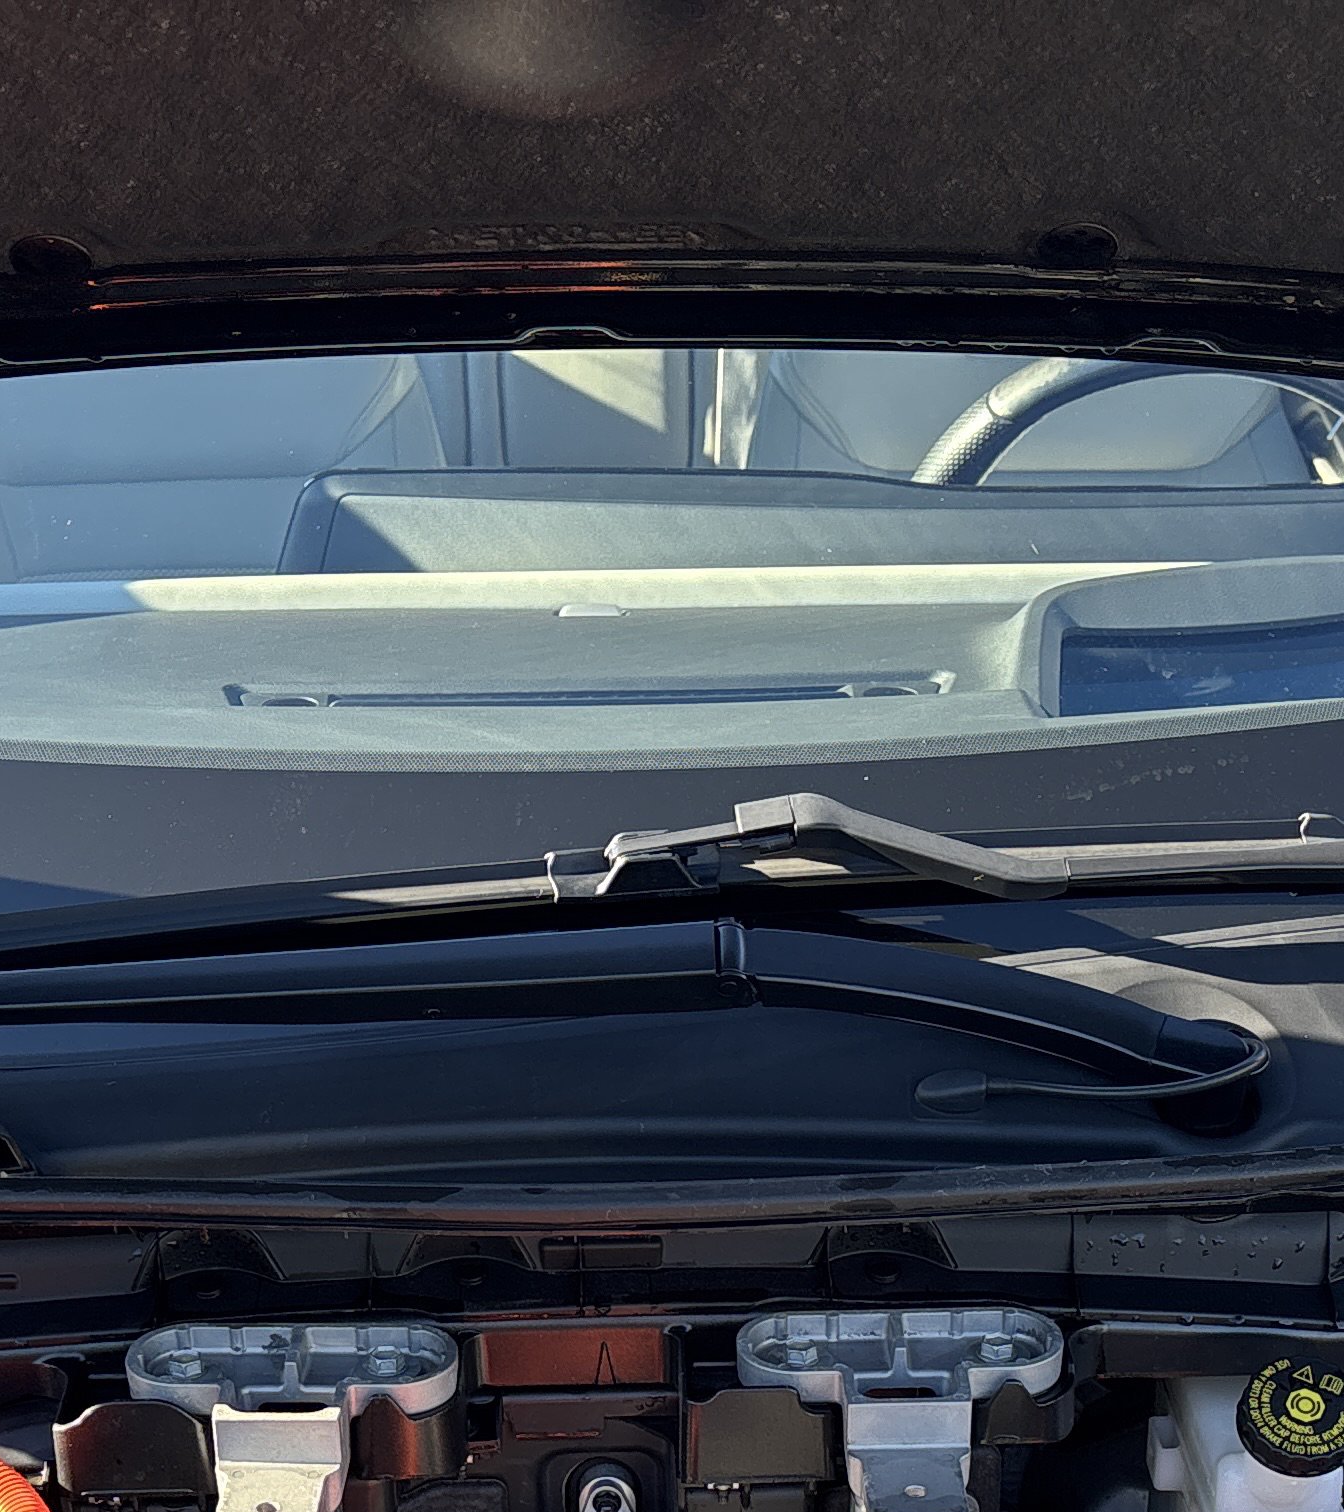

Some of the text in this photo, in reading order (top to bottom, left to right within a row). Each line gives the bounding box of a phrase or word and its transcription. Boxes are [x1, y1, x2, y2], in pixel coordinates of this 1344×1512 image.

[1260, 1380, 1277, 1403] CLEAN
[1260, 1403, 1278, 1427] FILLER
[1279, 1414, 1315, 1435] WARNING
[1260, 1426, 1284, 1447] BRAKE
[1282, 1441, 1306, 1455] FLUID
[1307, 1444, 1330, 1455] FROM
[1329, 1442, 1337, 1451] A
[1274, 1424, 1291, 1437] CAP
[1290, 1433, 1323, 1445] BEFORE
